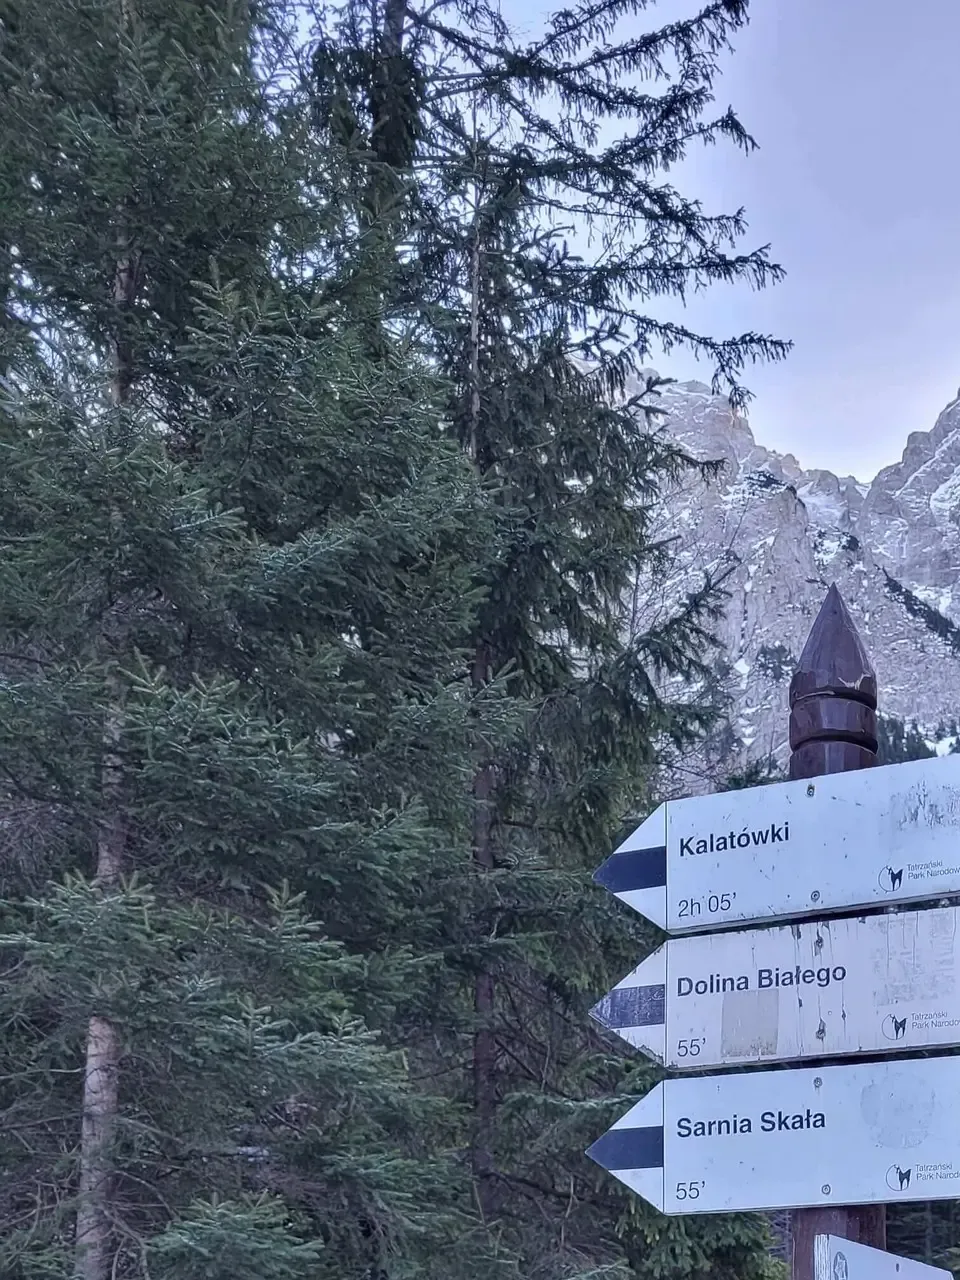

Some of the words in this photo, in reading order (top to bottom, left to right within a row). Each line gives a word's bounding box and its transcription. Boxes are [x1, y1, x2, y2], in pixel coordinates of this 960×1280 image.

[679, 821, 789, 857] Kalatówki
[906, 860, 943, 872] Tatrzański
[907, 872, 925, 880] Park
[678, 898, 701, 918] 2h
[708, 892, 736, 913] 05'
[677, 973, 749, 997] Dolina
[758, 965, 847, 989] Białego
[911, 1011, 948, 1021] Tatrzański
[911, 1021, 930, 1029] Park
[677, 1037, 706, 1058] 55'
[676, 1114, 752, 1138] Sarnia
[760, 1109, 826, 1133] Skała
[915, 1163, 952, 1172] Tatrzański
[675, 1180, 706, 1200] 55'
